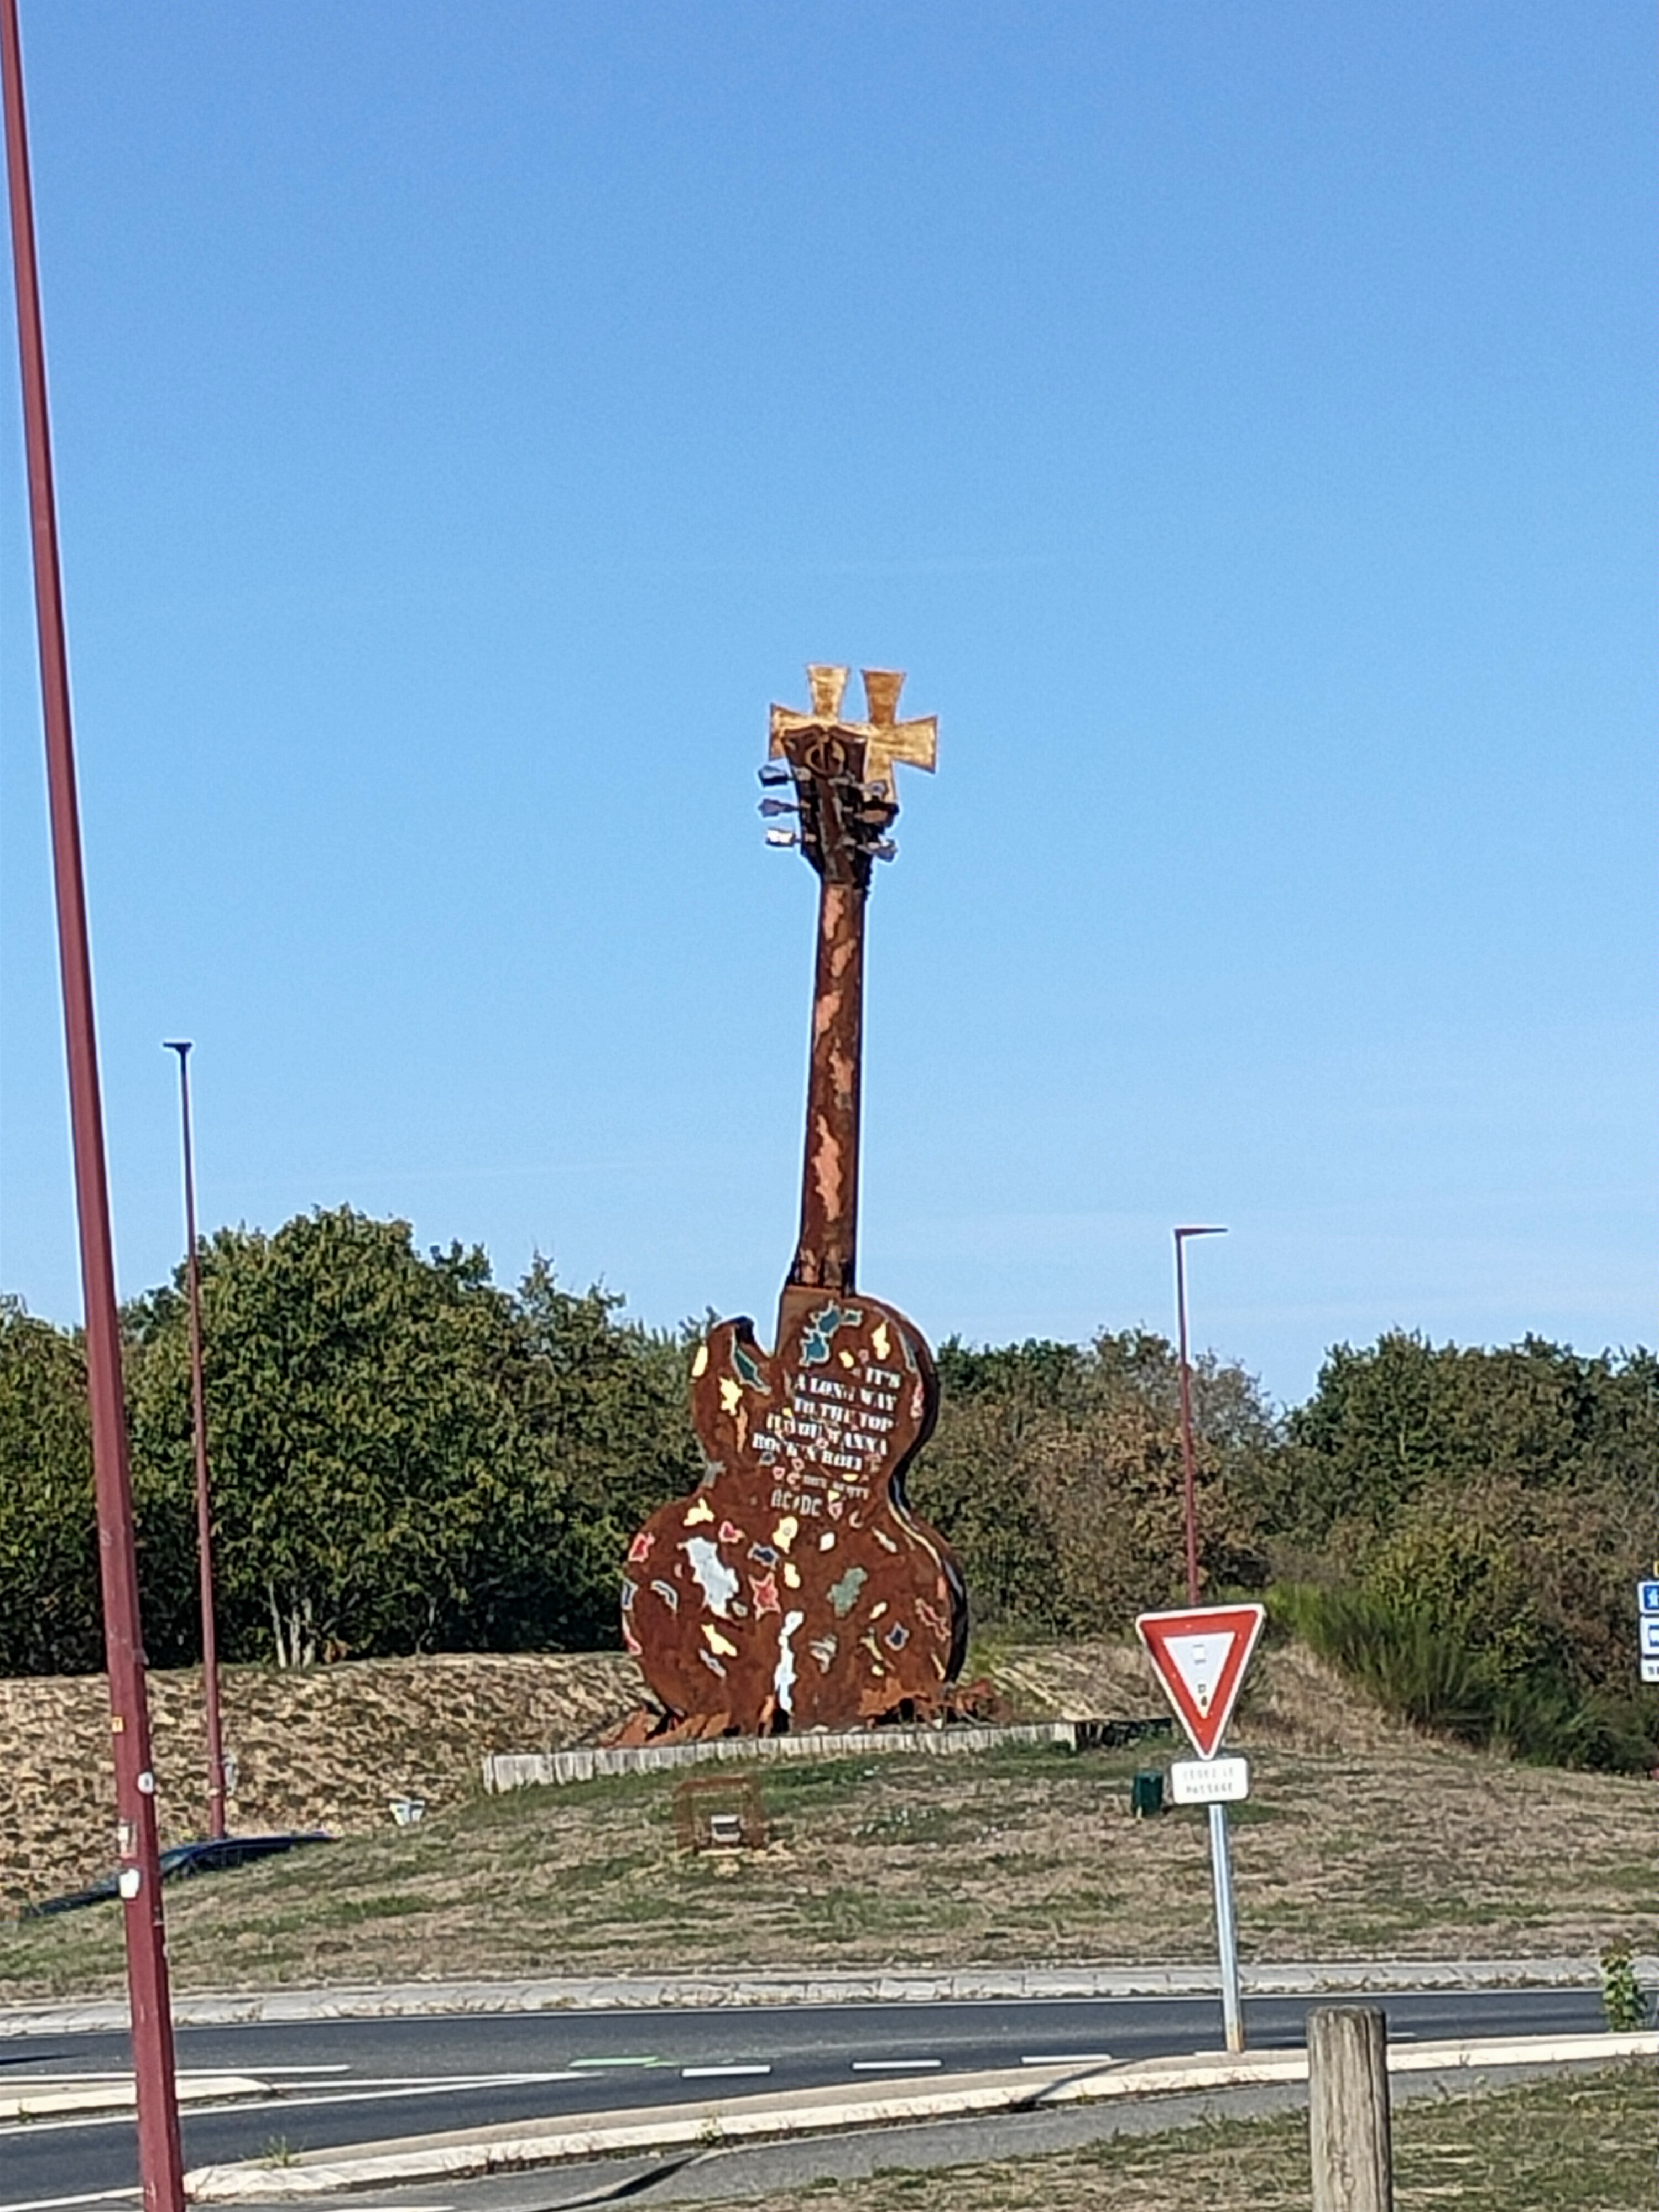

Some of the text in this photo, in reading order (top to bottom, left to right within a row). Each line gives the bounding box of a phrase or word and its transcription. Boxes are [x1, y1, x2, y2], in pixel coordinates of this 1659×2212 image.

[865, 1367, 901, 1389] IT'S
[794, 1374, 805, 1391] A
[860, 1388, 898, 1411] WAY
[794, 1397, 894, 1432] TO THE TOP
[828, 1429, 888, 1455] WANNA
[821, 1449, 863, 1471] ROLL
[771, 1489, 823, 1517] AC/DC
[1186, 1782, 1234, 1794] PASSAGE
